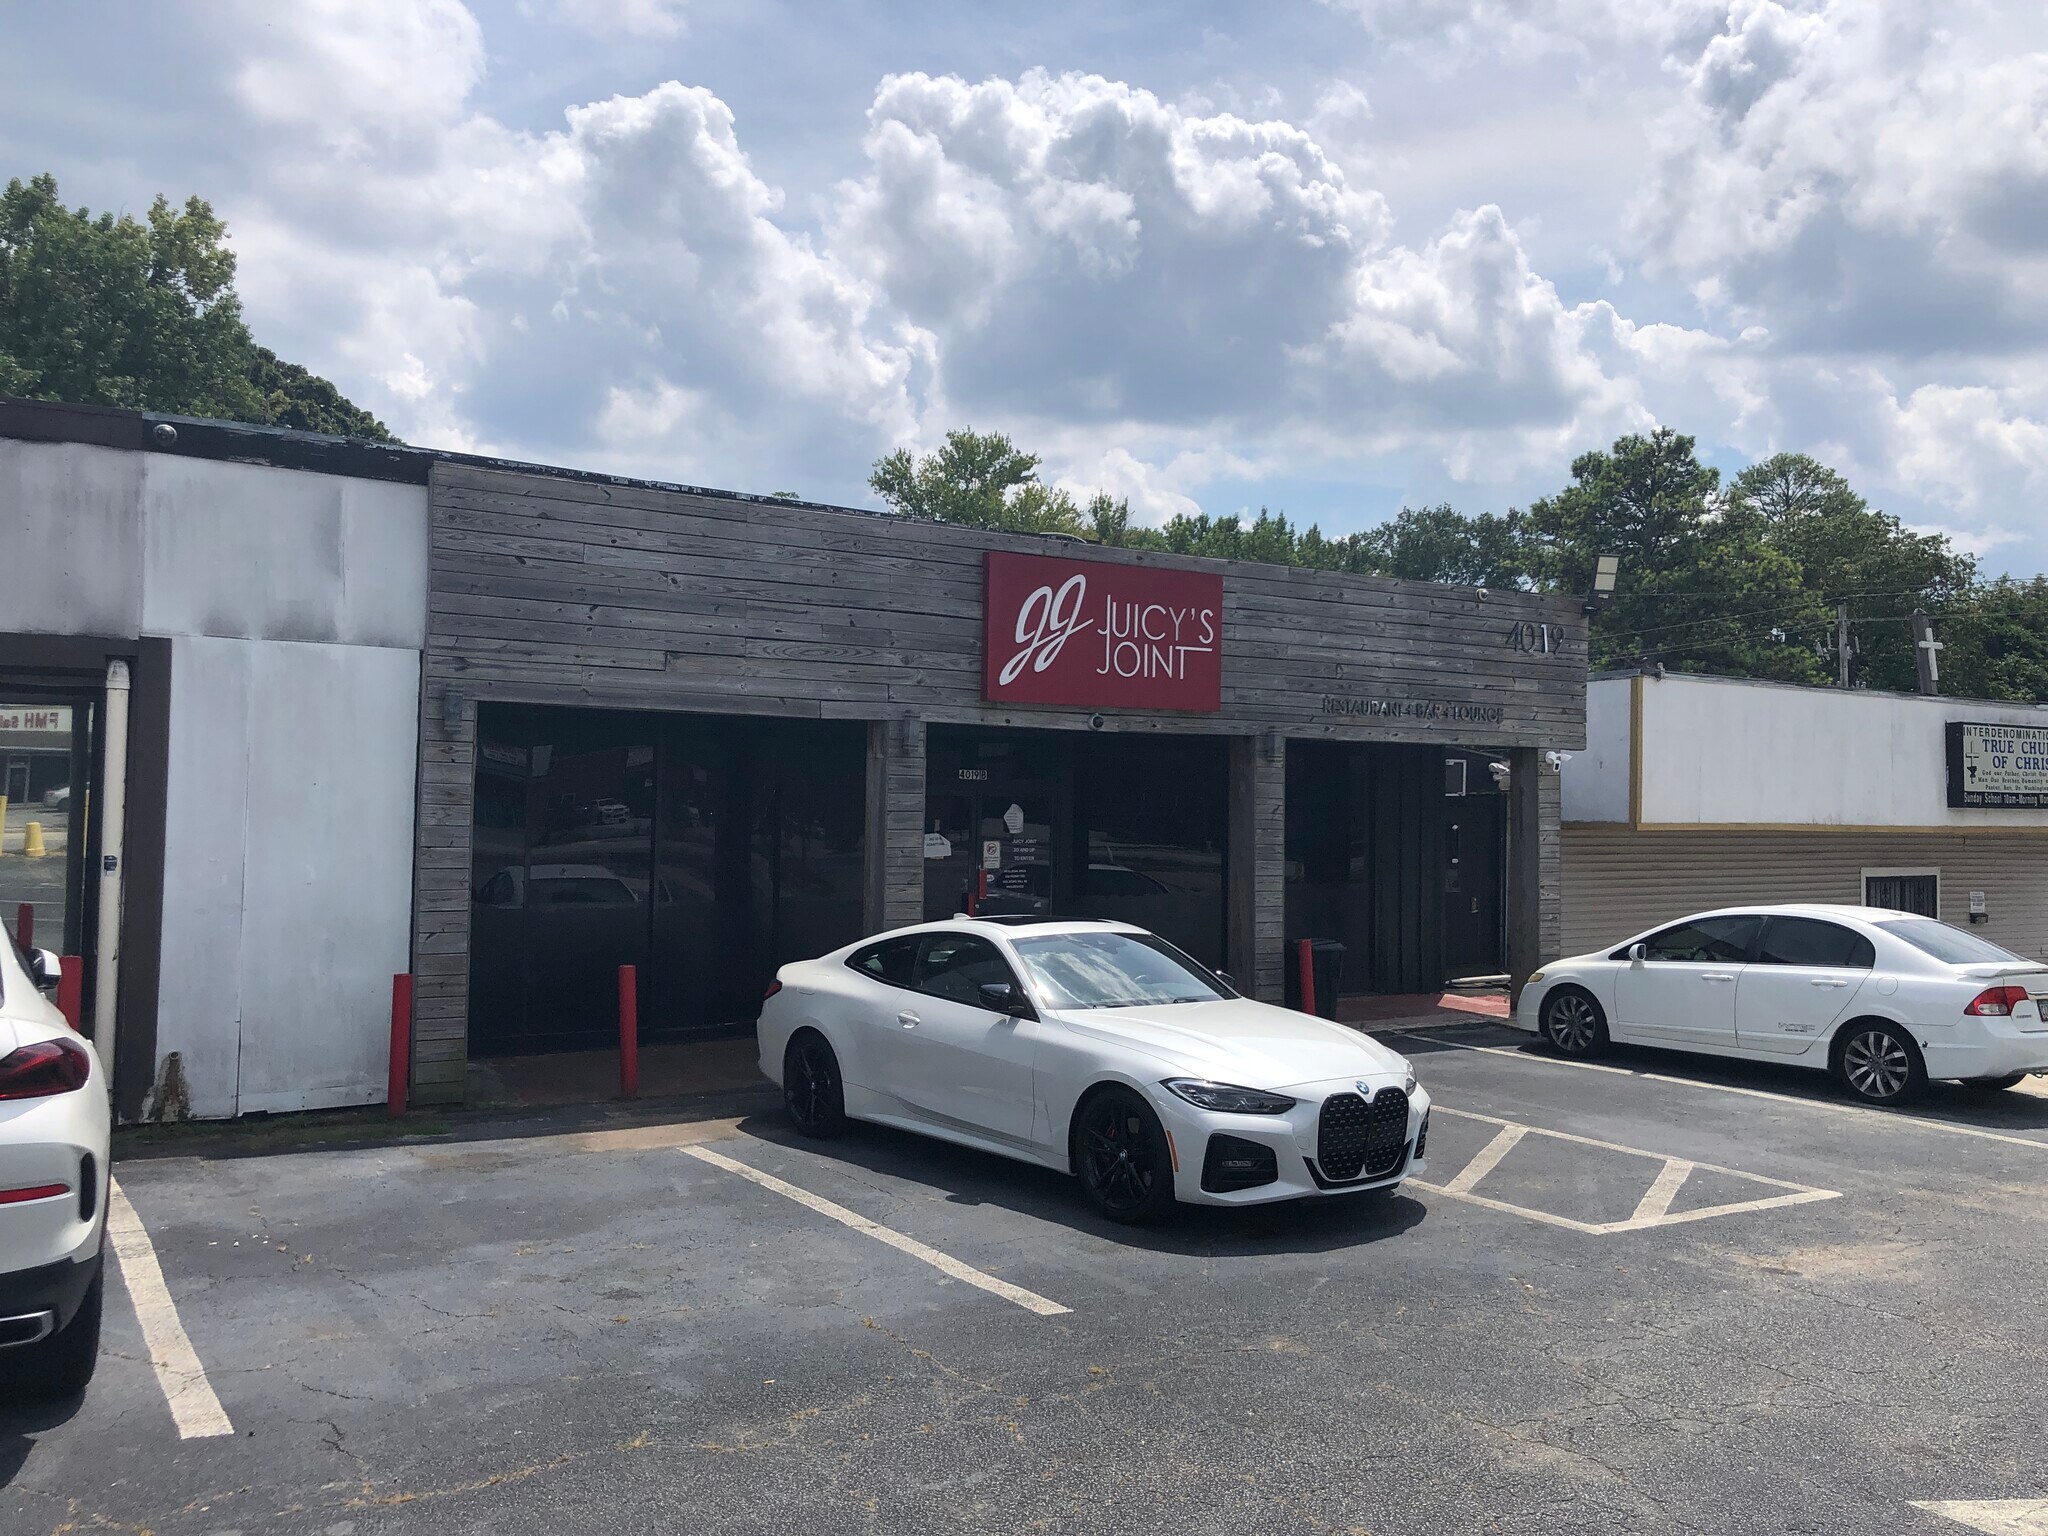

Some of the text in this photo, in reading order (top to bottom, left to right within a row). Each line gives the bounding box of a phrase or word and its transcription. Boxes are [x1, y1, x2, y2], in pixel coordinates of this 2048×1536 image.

[1097, 594, 1214, 644] JUICY'S
[1505, 621, 1566, 655] 4019
[1096, 641, 1213, 680] JOINT
[1322, 698, 1504, 724] RESTAURANT BAR LOUNGE
[1982, 739, 2048, 755] TRUE CHU
[1992, 755, 2008, 769] OF
[1964, 792, 1982, 805] Sunday
[1985, 793, 2002, 803] School
